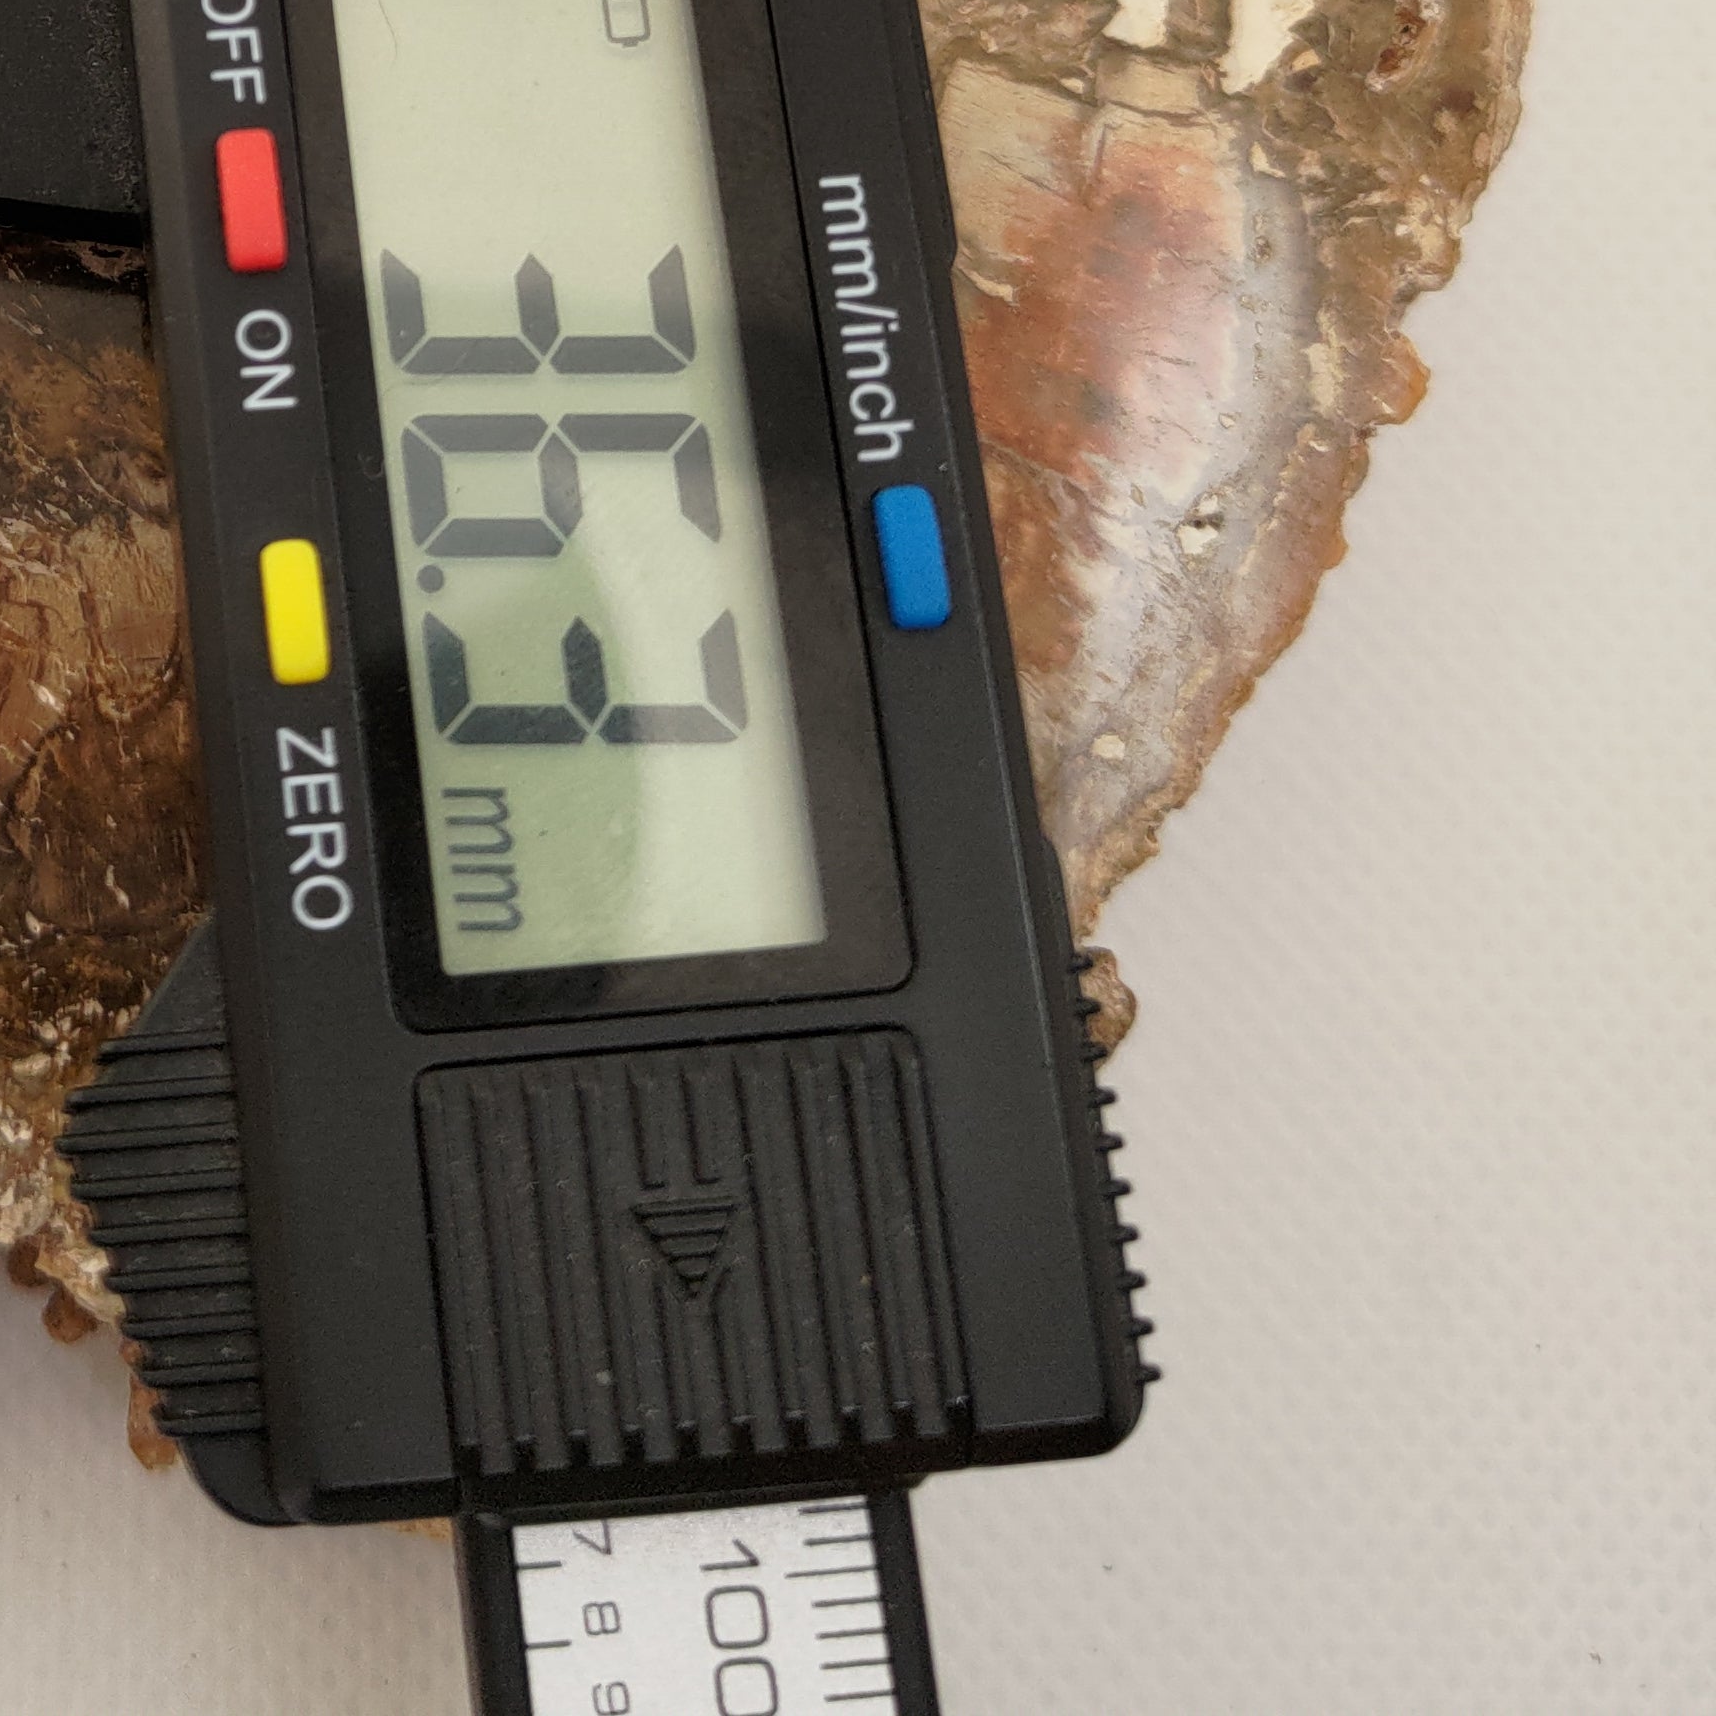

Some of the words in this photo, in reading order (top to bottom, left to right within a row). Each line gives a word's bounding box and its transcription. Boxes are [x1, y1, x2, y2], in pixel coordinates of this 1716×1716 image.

[234, 308, 298, 411] ON
[818, 173, 915, 463] mm/inch
[380, 244, 749, 745] 36.3
[276, 726, 353, 931] ZERO
[441, 785, 522, 936] mm
[582, 1601, 622, 1637] 8
[592, 1680, 631, 1716] 9
[699, 1538, 780, 1716] 100
